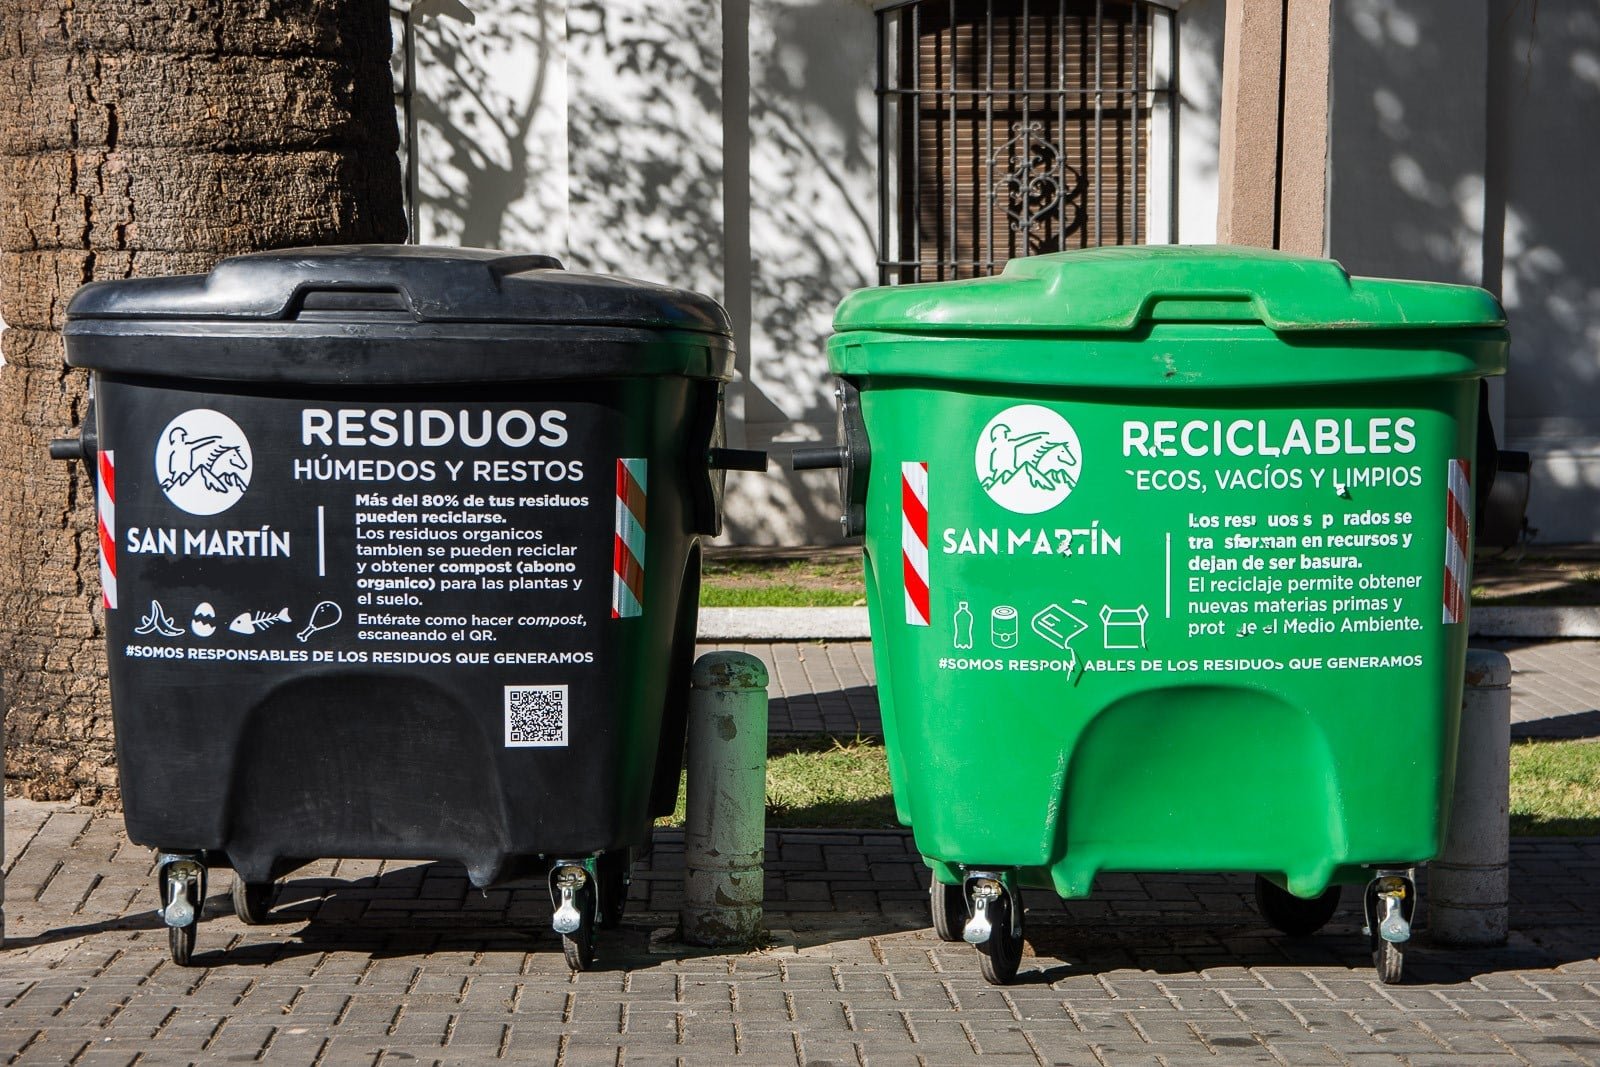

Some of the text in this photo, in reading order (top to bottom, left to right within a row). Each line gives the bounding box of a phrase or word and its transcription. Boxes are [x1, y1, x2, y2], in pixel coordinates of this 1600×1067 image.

[301, 408, 569, 448] RESIDUOS
[1122, 416, 1416, 458] RECICLABLES
[293, 453, 584, 482] HÚMEDOS Y RESTOS
[1125, 463, 1422, 494] ECOS, VACÍOS Y LIMPIOS
[355, 492, 589, 507] Más del 80% de tus residuos
[355, 510, 507, 525] pueden reciclarse.
[1188, 509, 1413, 530] Los resiuos sprados se
[127, 524, 291, 558] SAN MARTÍN
[356, 526, 543, 543] Los residuos organicos
[942, 527, 999, 555] SAN
[1187, 533, 1413, 550] trasforman en recursos y
[427, 546, 446, 557] se
[450, 543, 512, 559] pueden
[517, 543, 578, 557] reciclar
[356, 559, 576, 576] y obtener compost (abono
[1187, 553, 1363, 574] dejan de ser basura.
[356, 576, 583, 592] organico) para las plantas y
[1188, 573, 1423, 595] El reciclaje permite obtener
[357, 592, 423, 606] el suelo.
[1188, 595, 1403, 615] nuevas materias primas y
[357, 612, 587, 628] Entérate como hacer compost,
[1283, 617, 1336, 634] Medio
[1340, 615, 1424, 633] Ambiente.
[357, 629, 497, 642] escaneando el QR.
[125, 644, 594, 664] #SOMOS RESPONSABLES DE LOS RESIDUOS QUE GENERAMOS
[938, 657, 1004, 671] #SOMOS
[1008, 659, 1136, 672] RESPONABLES
[1140, 659, 1163, 672] DE
[1167, 659, 1199, 672] LOS
[1288, 657, 1323, 670] QUE
[1326, 654, 1423, 669] GENERAMOS
